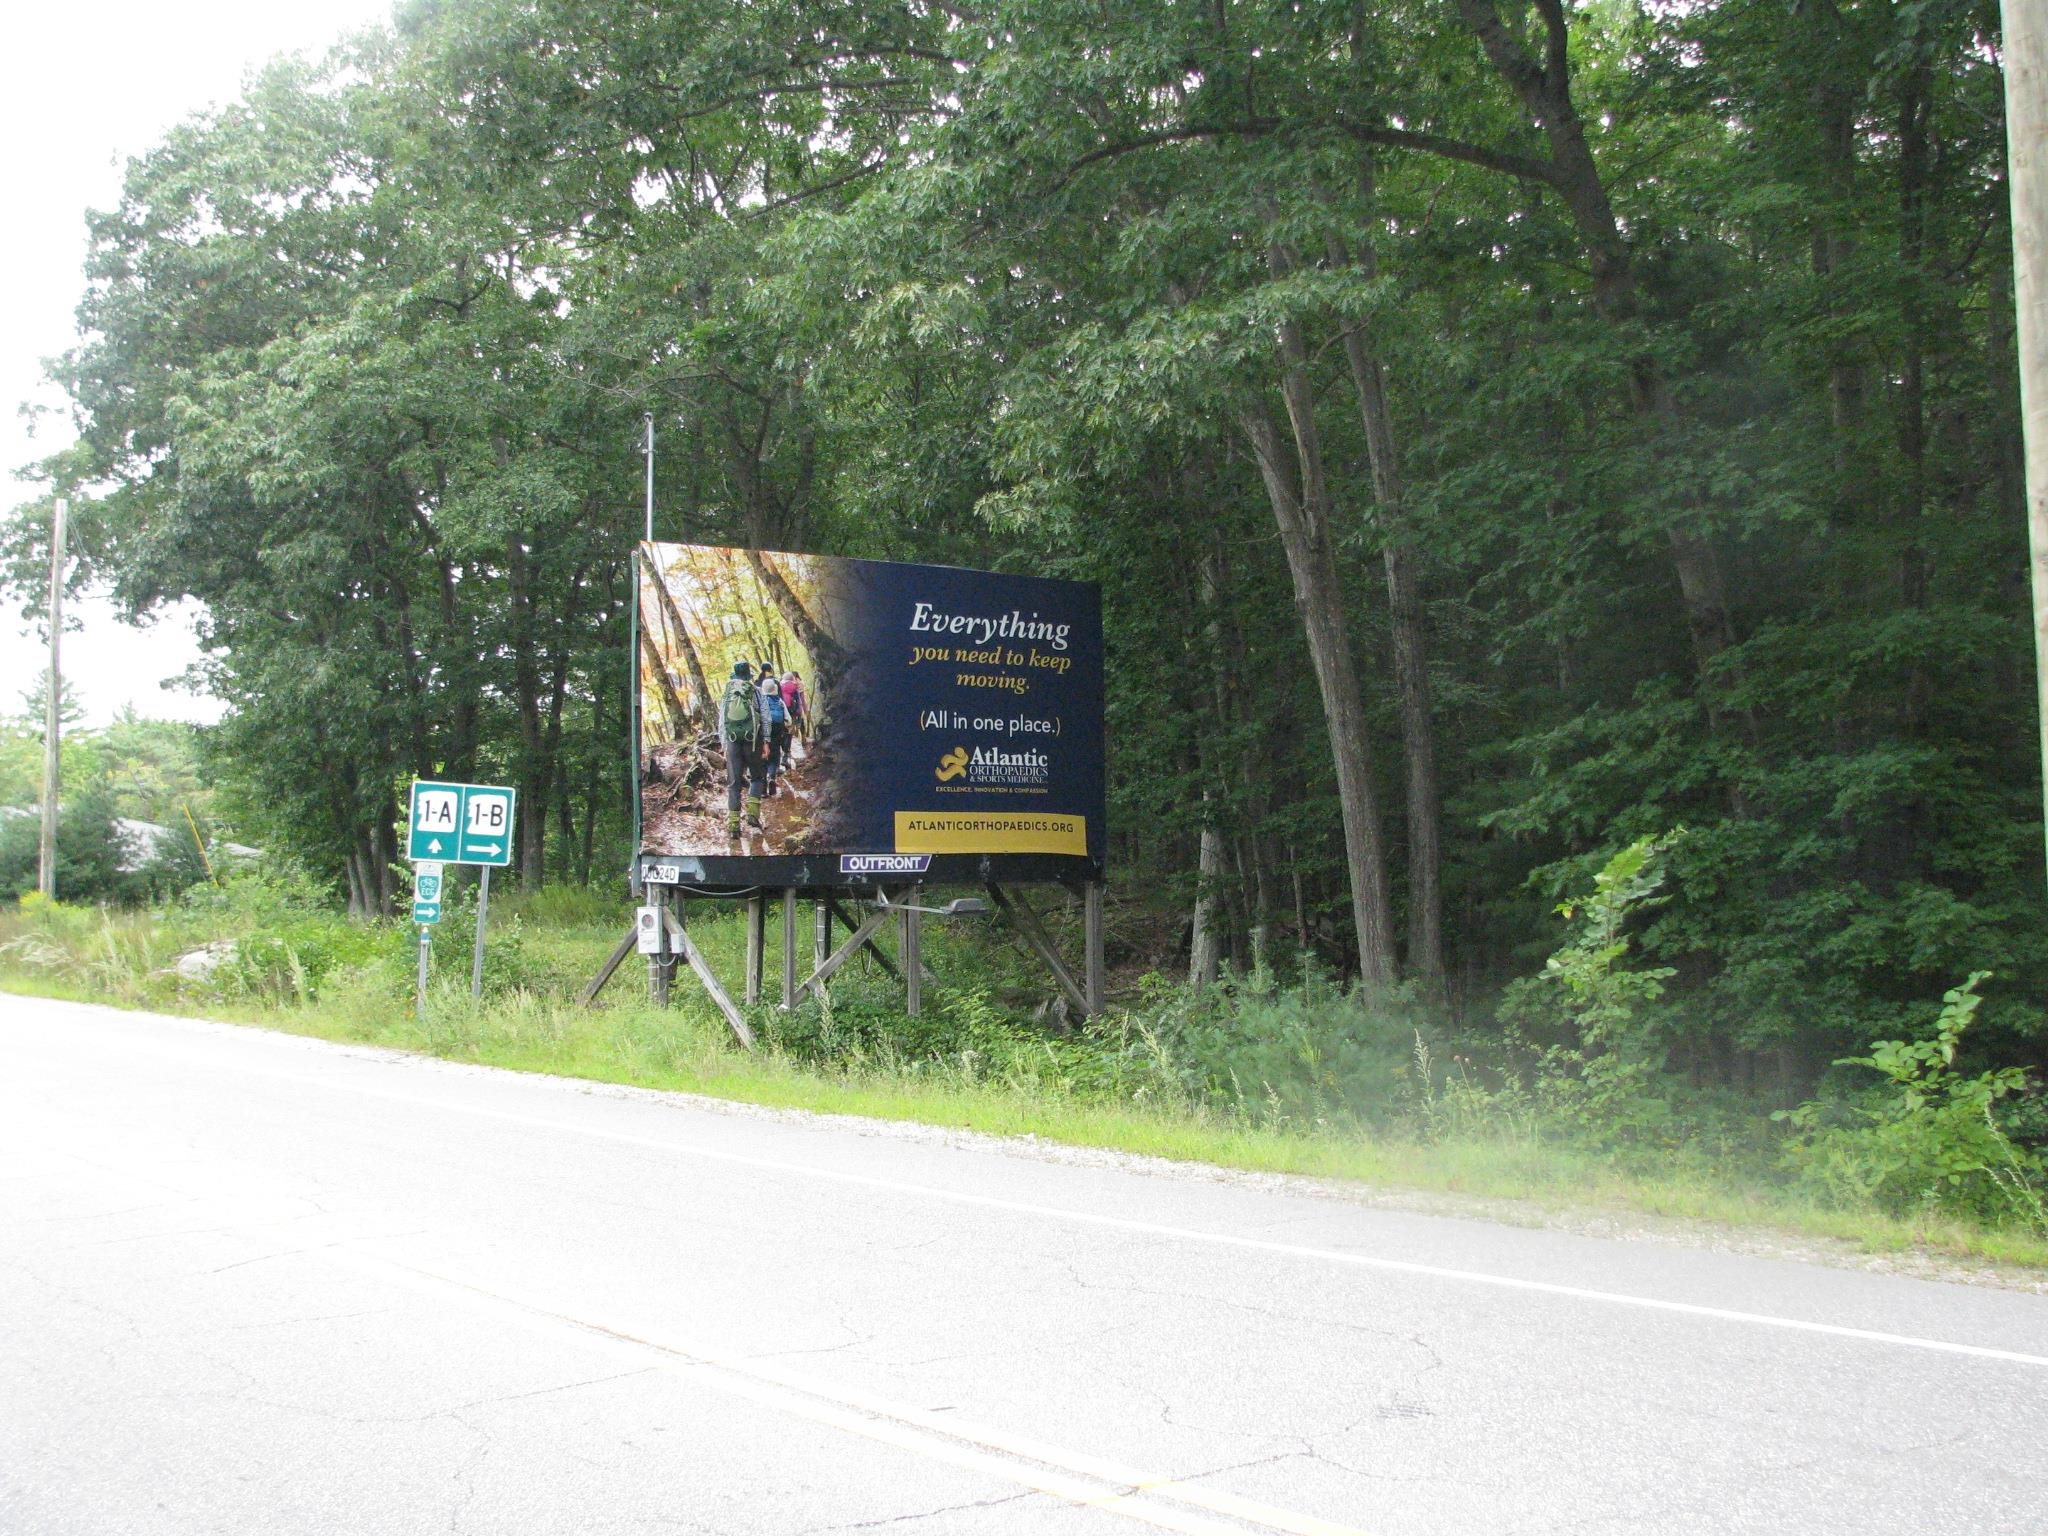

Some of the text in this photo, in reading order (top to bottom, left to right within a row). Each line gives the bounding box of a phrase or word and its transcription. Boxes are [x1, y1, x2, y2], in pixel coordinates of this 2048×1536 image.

[910, 602, 1070, 650] Everything
[909, 646, 1071, 674] you need to keep
[956, 671, 1030, 694] moving.
[920, 710, 1061, 737] (All in one place.)
[969, 746, 1048, 767] Atlantic
[969, 765, 1048, 777] ORTHOPAEDICS
[969, 775, 1043, 784] & SPORTS MEDICINE
[425, 799, 452, 824] 1-A
[475, 803, 504, 827] 1-B
[908, 820, 1074, 833] ATLANTICORTHOPAEDICS.ORG
[849, 856, 922, 870] OUTFRONT
